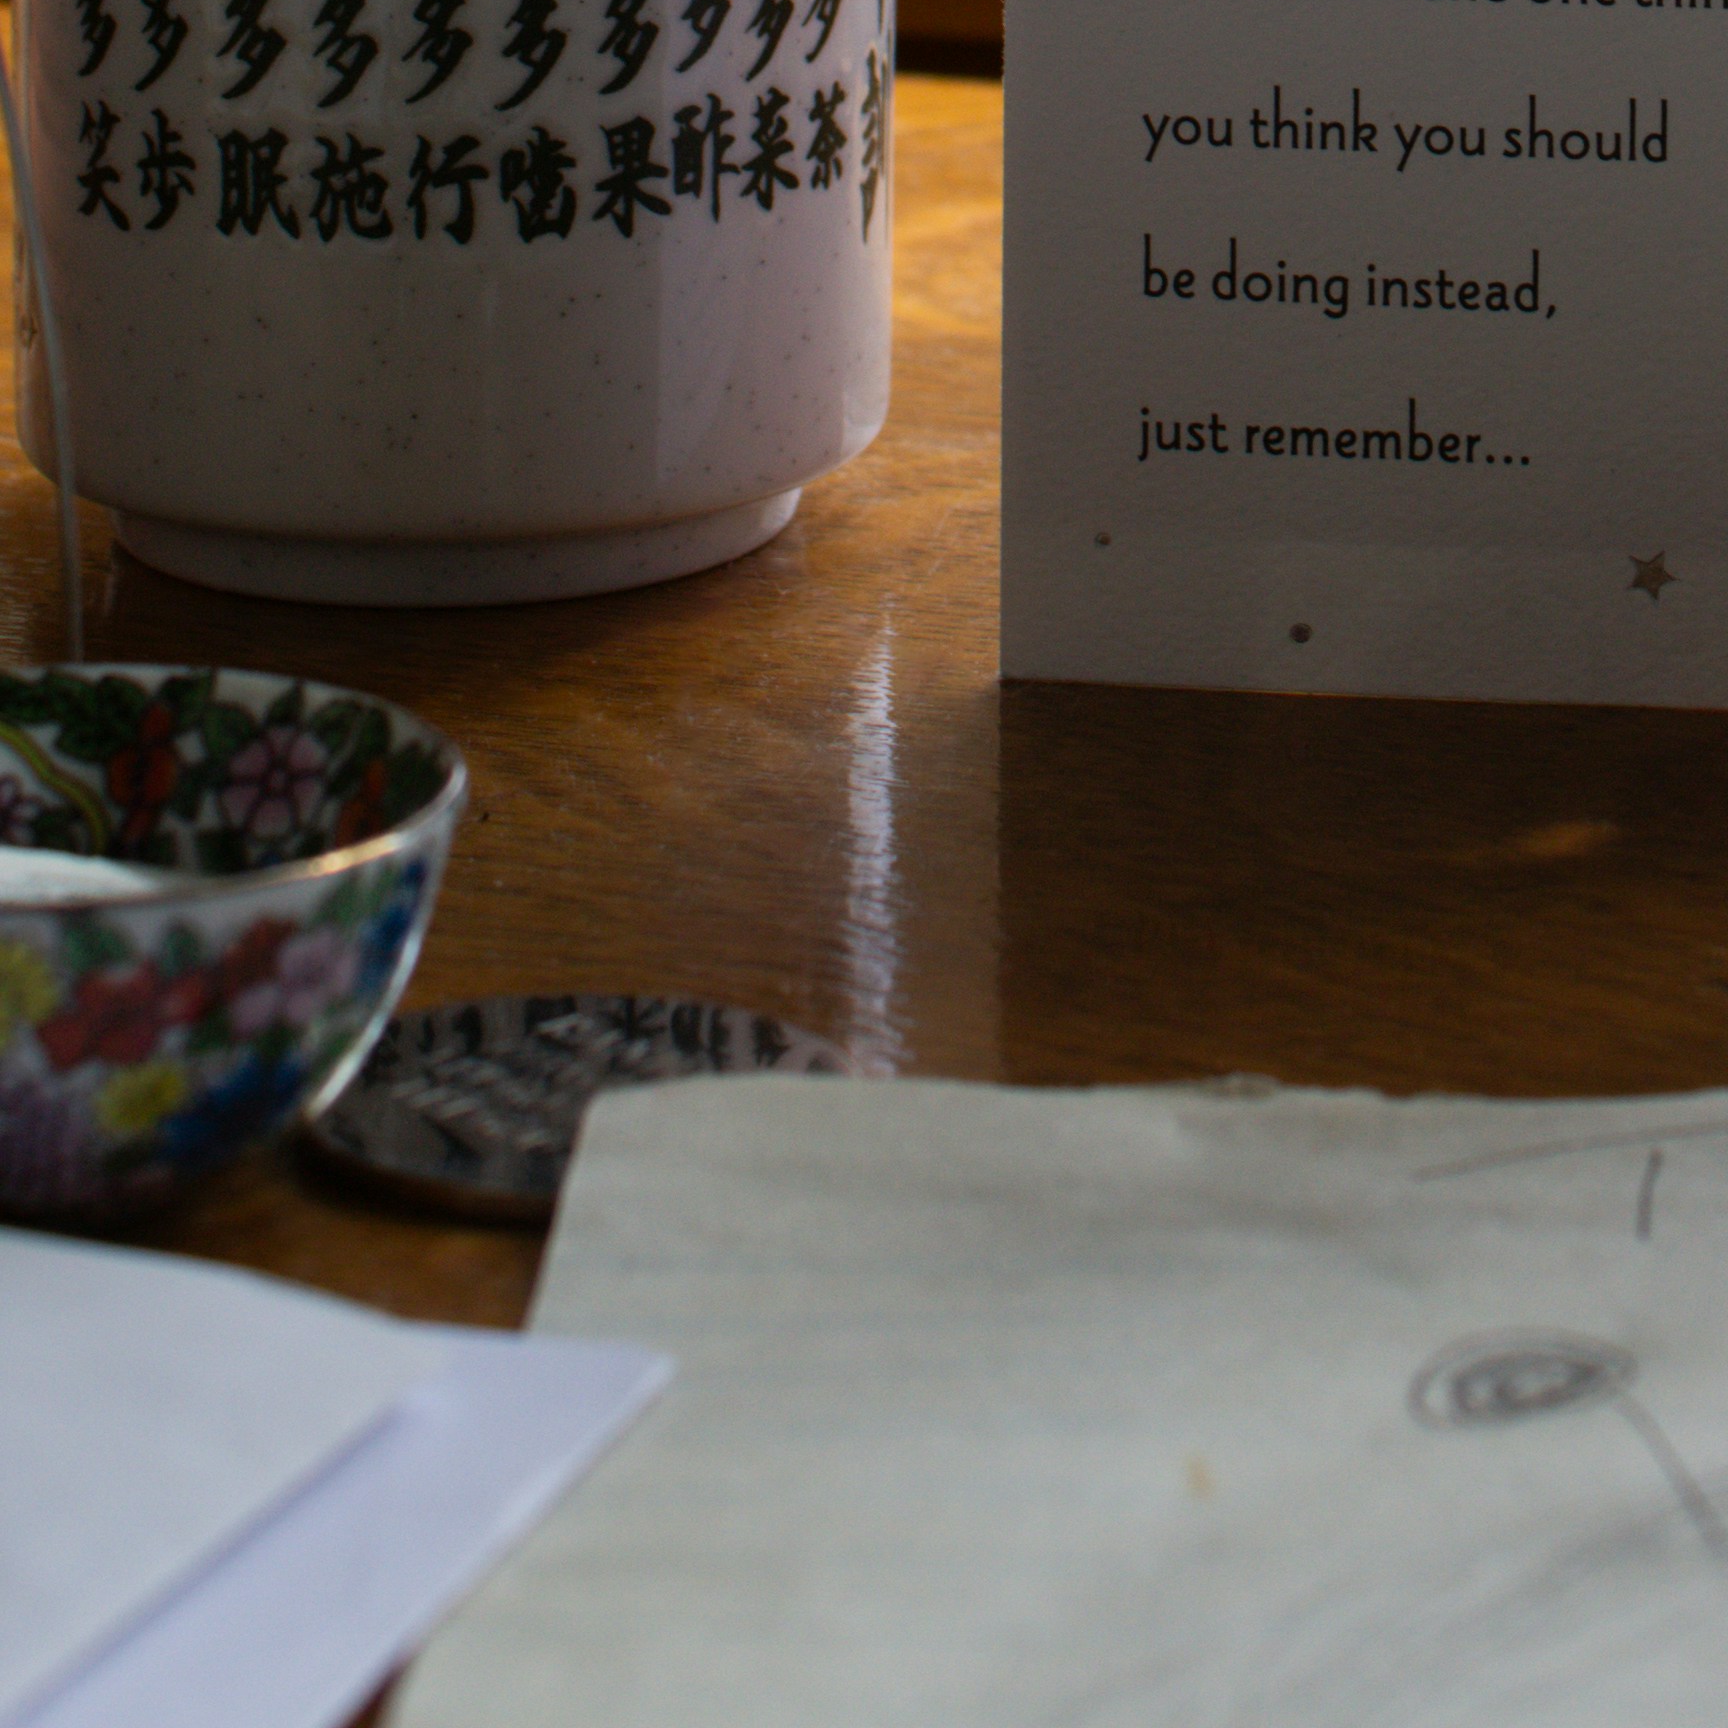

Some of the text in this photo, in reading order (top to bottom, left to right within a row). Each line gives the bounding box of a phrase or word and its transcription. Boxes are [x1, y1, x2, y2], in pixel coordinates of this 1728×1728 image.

[1141, 83, 1669, 174] you think you should
[1142, 232, 1557, 321] be doing instead,
[1136, 396, 1531, 467] just remember...
